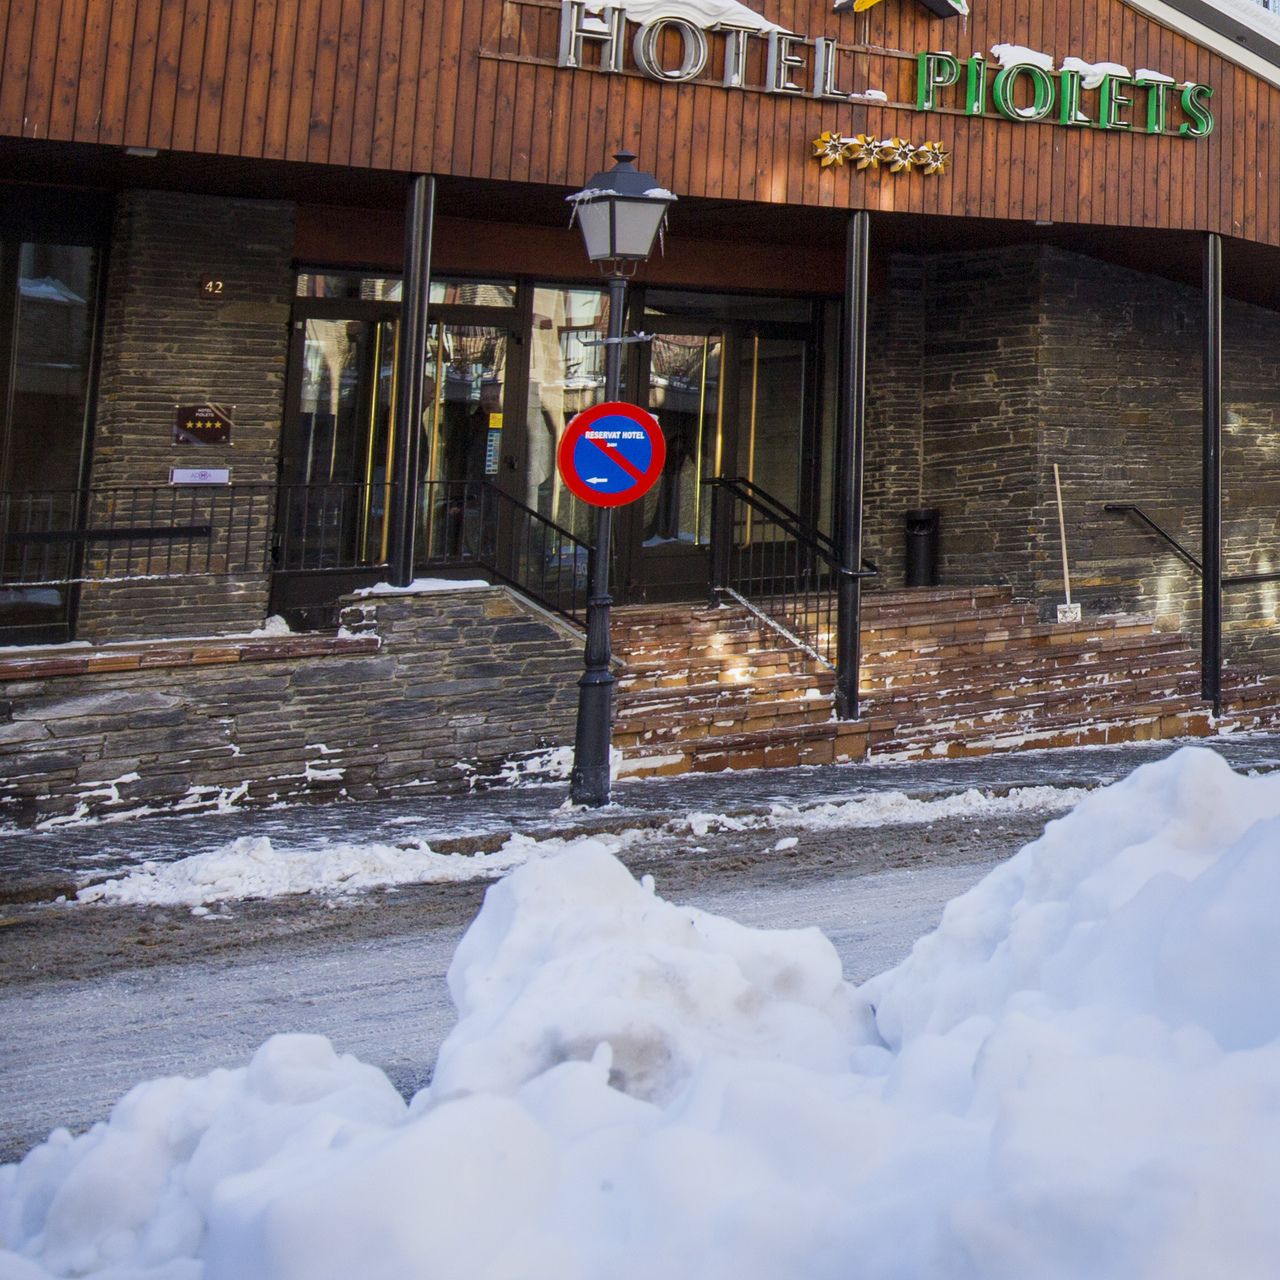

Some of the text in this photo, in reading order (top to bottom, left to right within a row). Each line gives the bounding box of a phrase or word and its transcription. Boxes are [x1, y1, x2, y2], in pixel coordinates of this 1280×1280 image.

[560, 0, 1215, 139] HOTEL PIOLETS
[205, 281, 223, 293] 42
[585, 431, 645, 439] RESERVAT HOTEL
